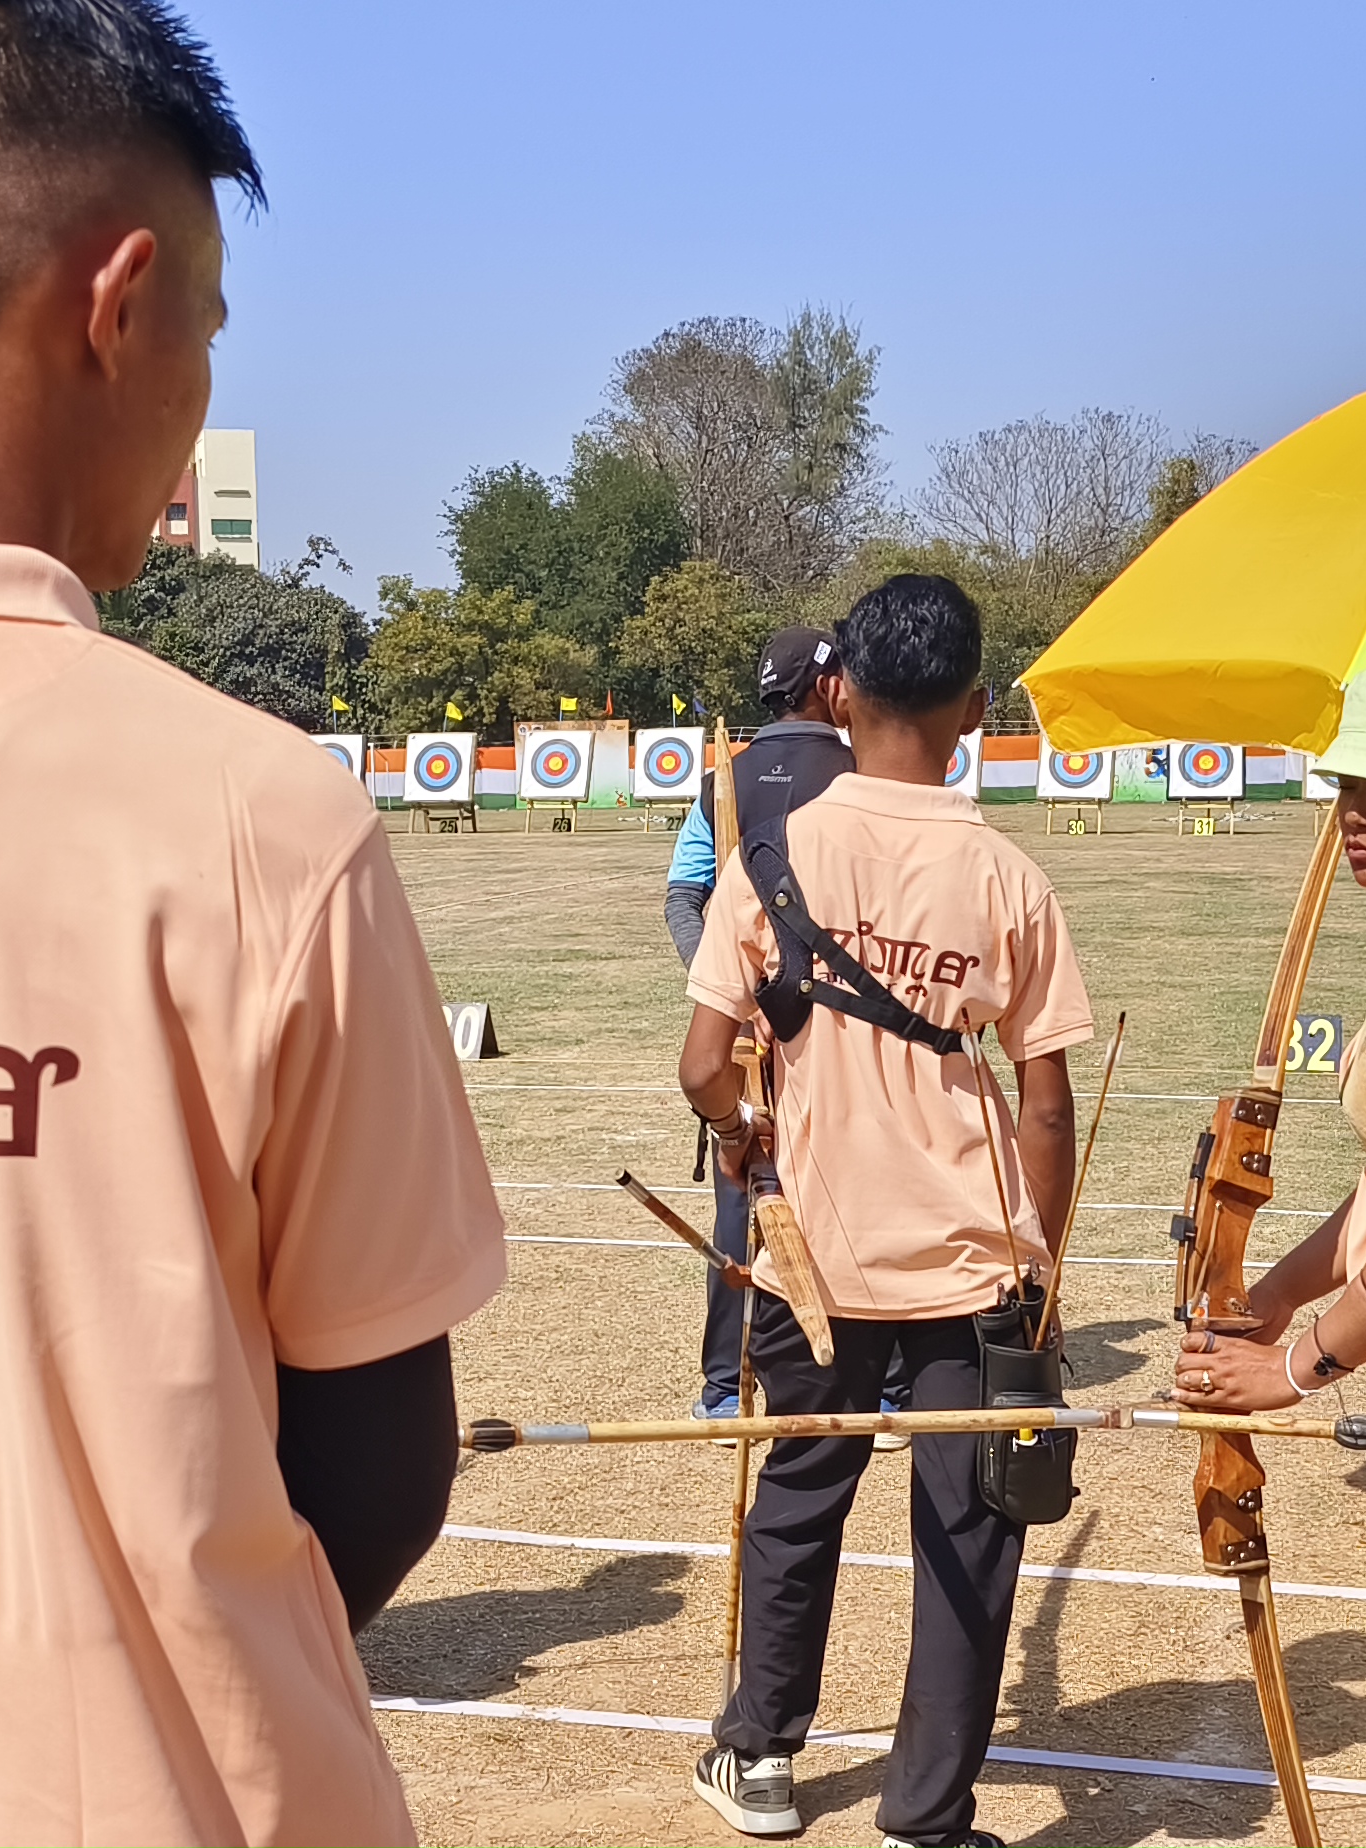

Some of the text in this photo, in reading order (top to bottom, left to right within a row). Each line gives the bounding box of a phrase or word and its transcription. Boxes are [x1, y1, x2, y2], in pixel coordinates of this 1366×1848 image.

[440, 821, 455, 833] 25
[554, 819, 568, 832] 26
[667, 817, 681, 830] 27
[1068, 820, 1085, 835] 30
[1196, 819, 1211, 835] 31
[1285, 1018, 1335, 1072] 32
